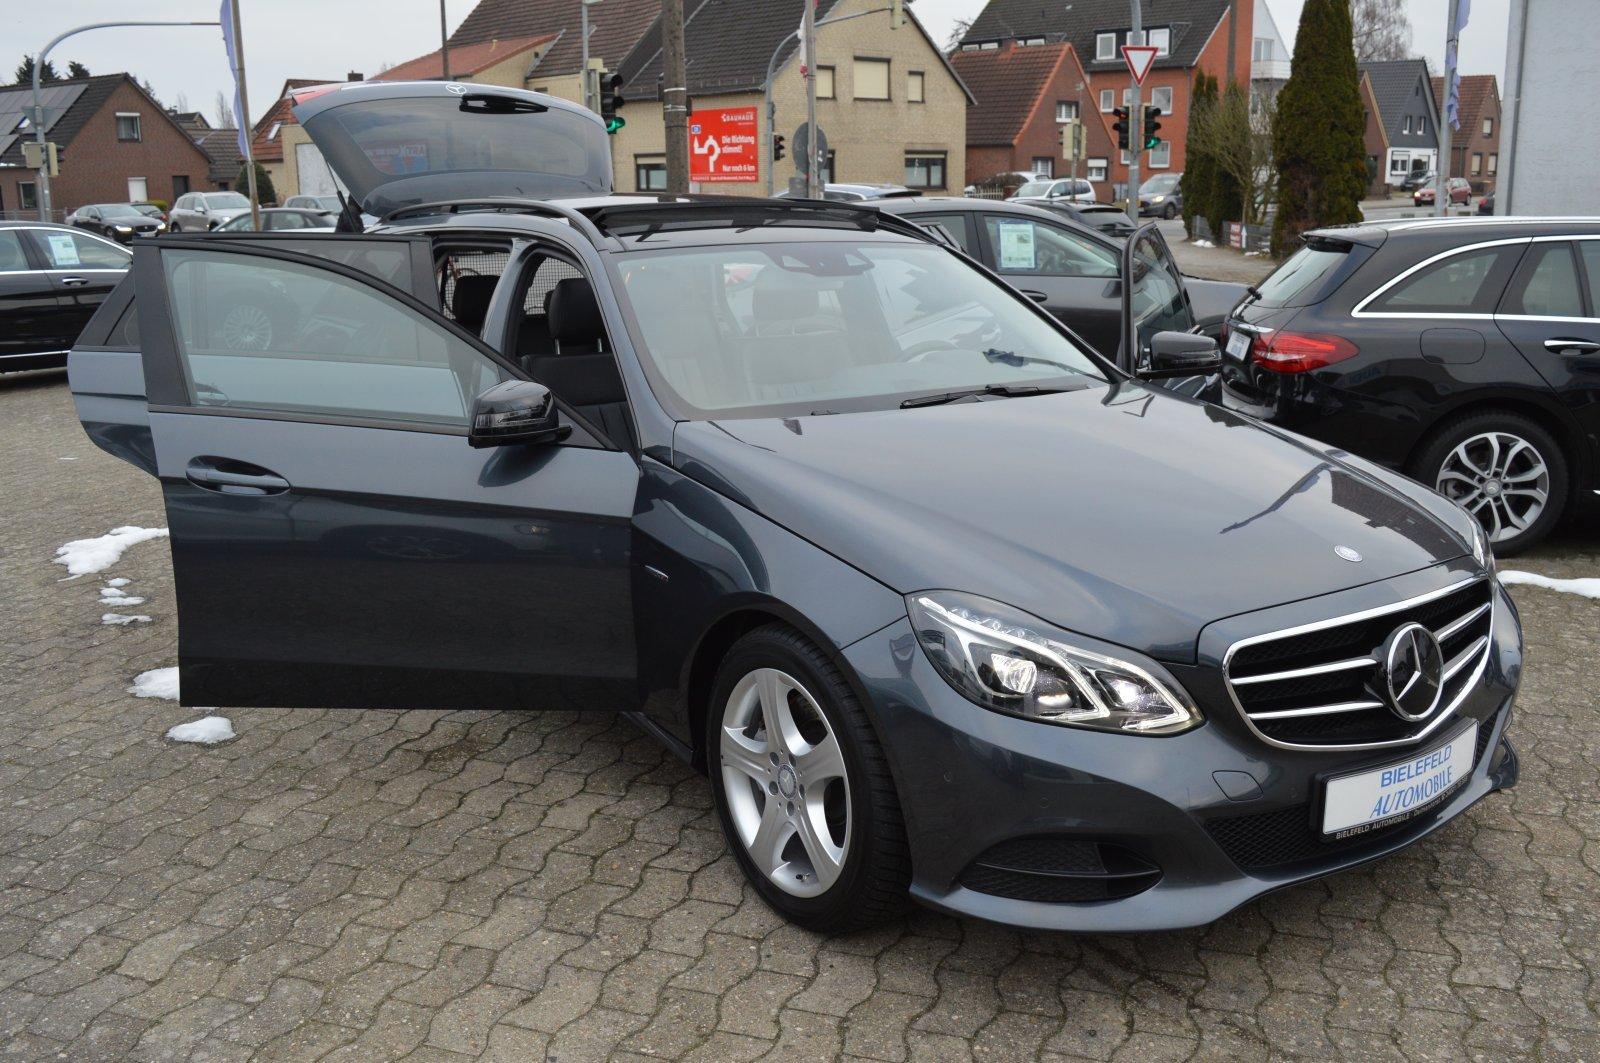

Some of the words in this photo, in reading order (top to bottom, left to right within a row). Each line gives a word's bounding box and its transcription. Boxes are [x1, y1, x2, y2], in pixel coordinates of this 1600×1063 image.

[726, 113, 754, 121] BAUHAUS
[1380, 744, 1452, 788] BIELEFELD
[1369, 765, 1453, 819] AUTOMOBILE
[1335, 824, 1370, 840] BIELEFELD
[1372, 813, 1411, 830] AUTOMOBILE
